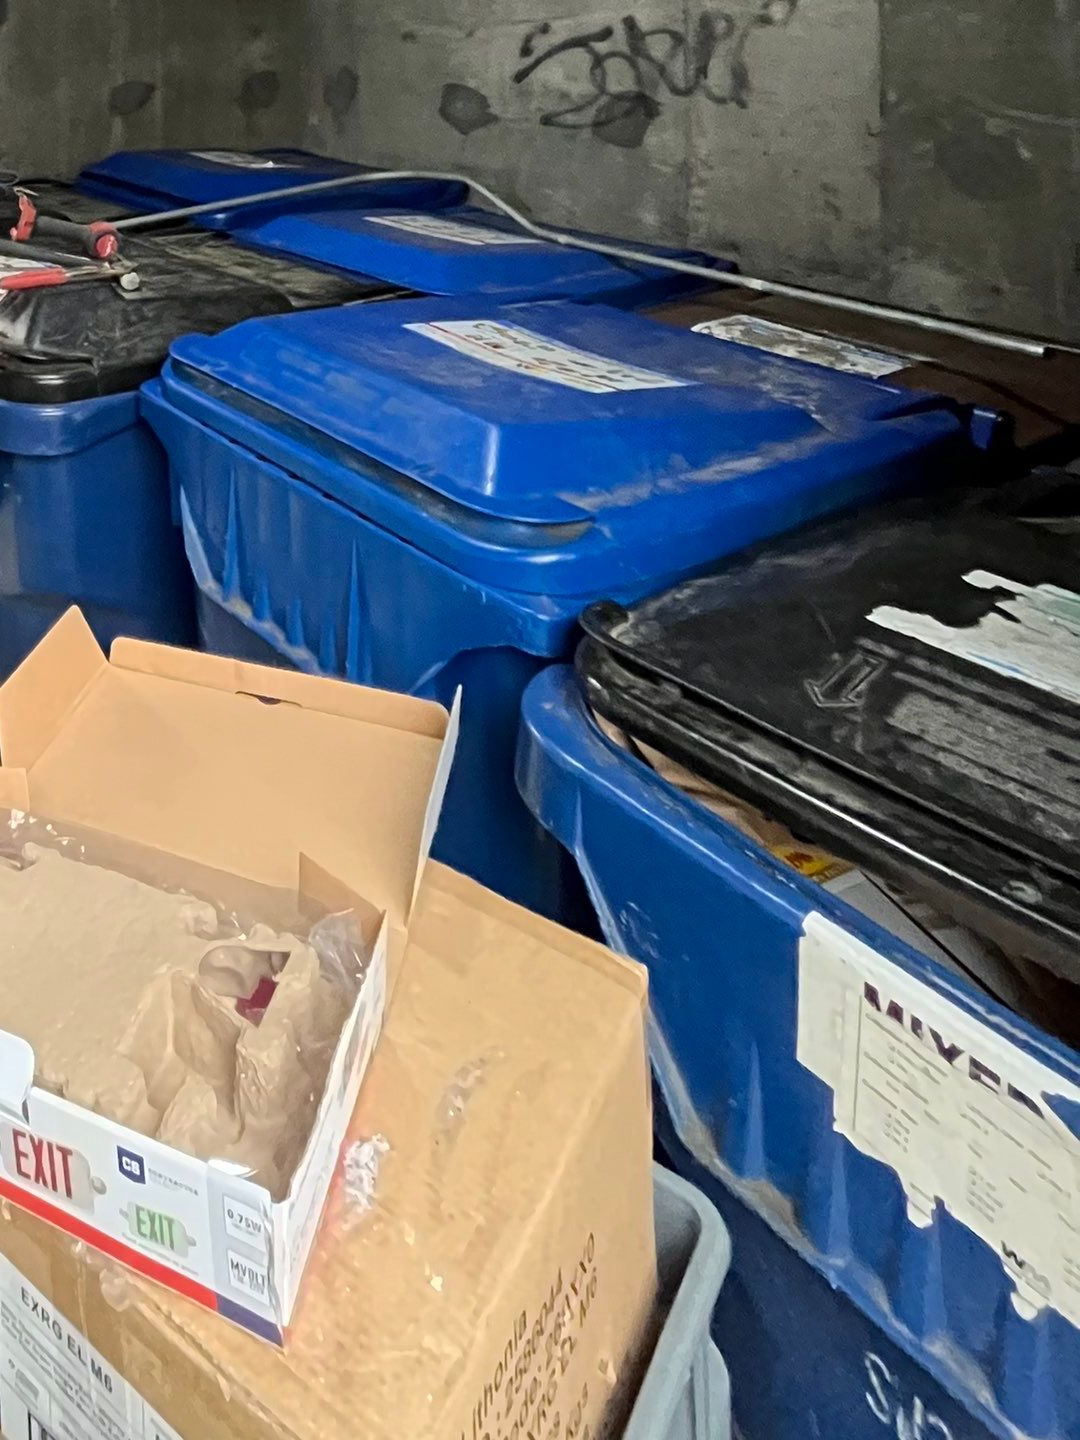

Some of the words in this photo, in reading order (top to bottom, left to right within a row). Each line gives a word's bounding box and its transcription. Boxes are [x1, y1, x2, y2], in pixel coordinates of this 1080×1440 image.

[11, 1128, 73, 1200] EXIT
[135, 1207, 176, 1251] EXIT
[21, 1286, 63, 1340] EXRG
[67, 1335, 86, 1366] EL
[90, 1359, 113, 1393] M6
[461, 1310, 527, 1440] ithonia
